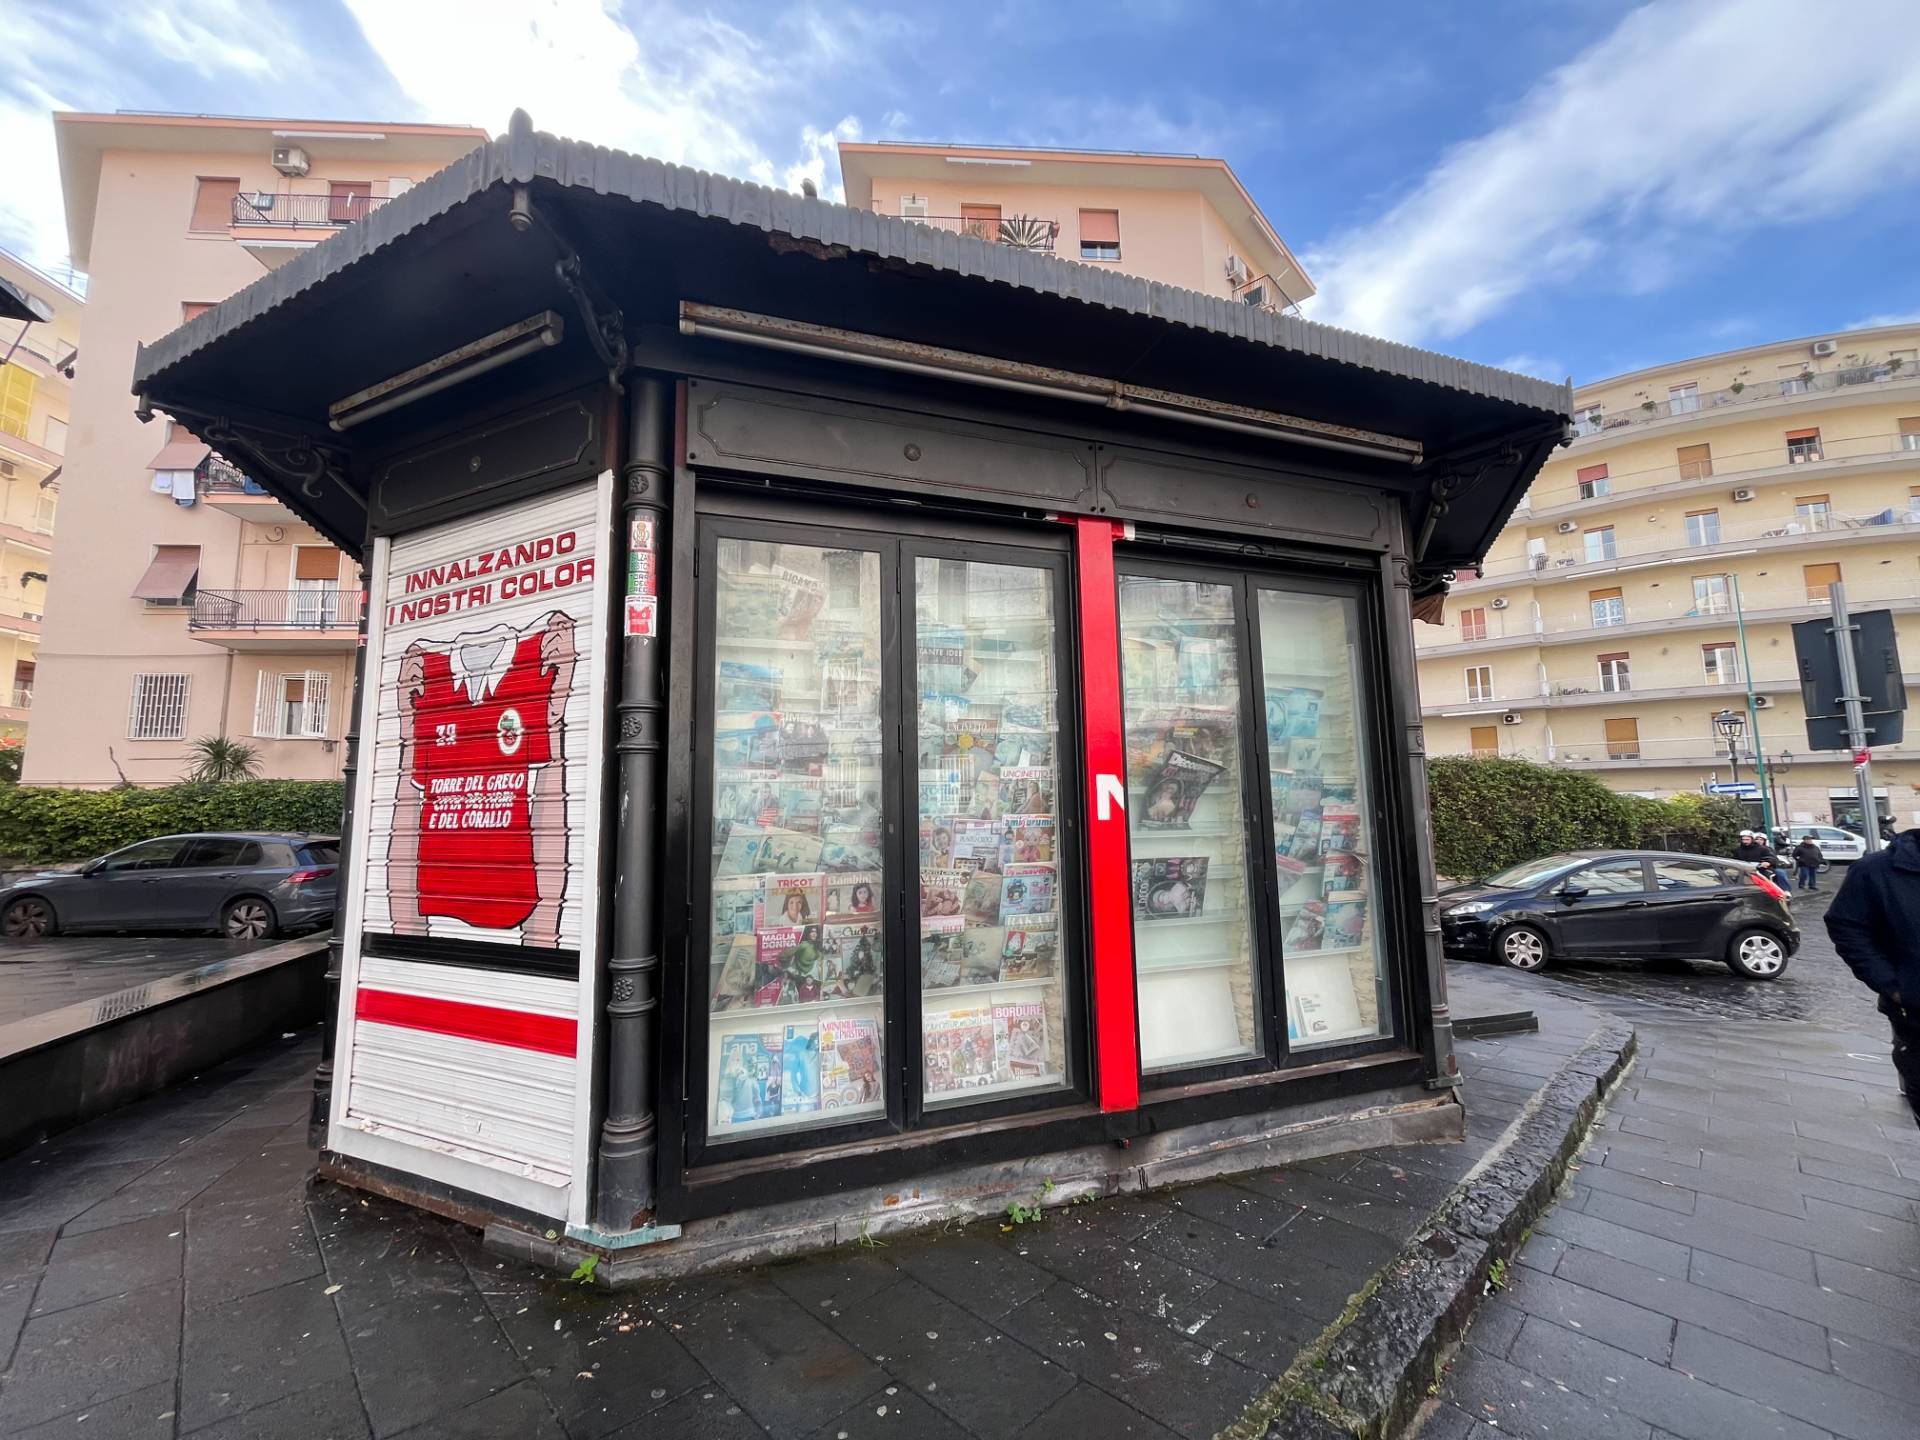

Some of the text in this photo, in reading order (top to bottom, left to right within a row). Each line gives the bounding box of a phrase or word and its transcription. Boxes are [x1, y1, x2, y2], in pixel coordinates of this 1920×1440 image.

[405, 531, 576, 593] INNALZANDO
[389, 607, 396, 625] I
[400, 584, 492, 623] NOSTRI
[430, 773, 525, 794] TORRE DEL GRECO
[428, 810, 512, 829] E DEL CORALLO
[777, 878, 814, 887] TRICOT
[762, 934, 796, 942] MAGLIA
